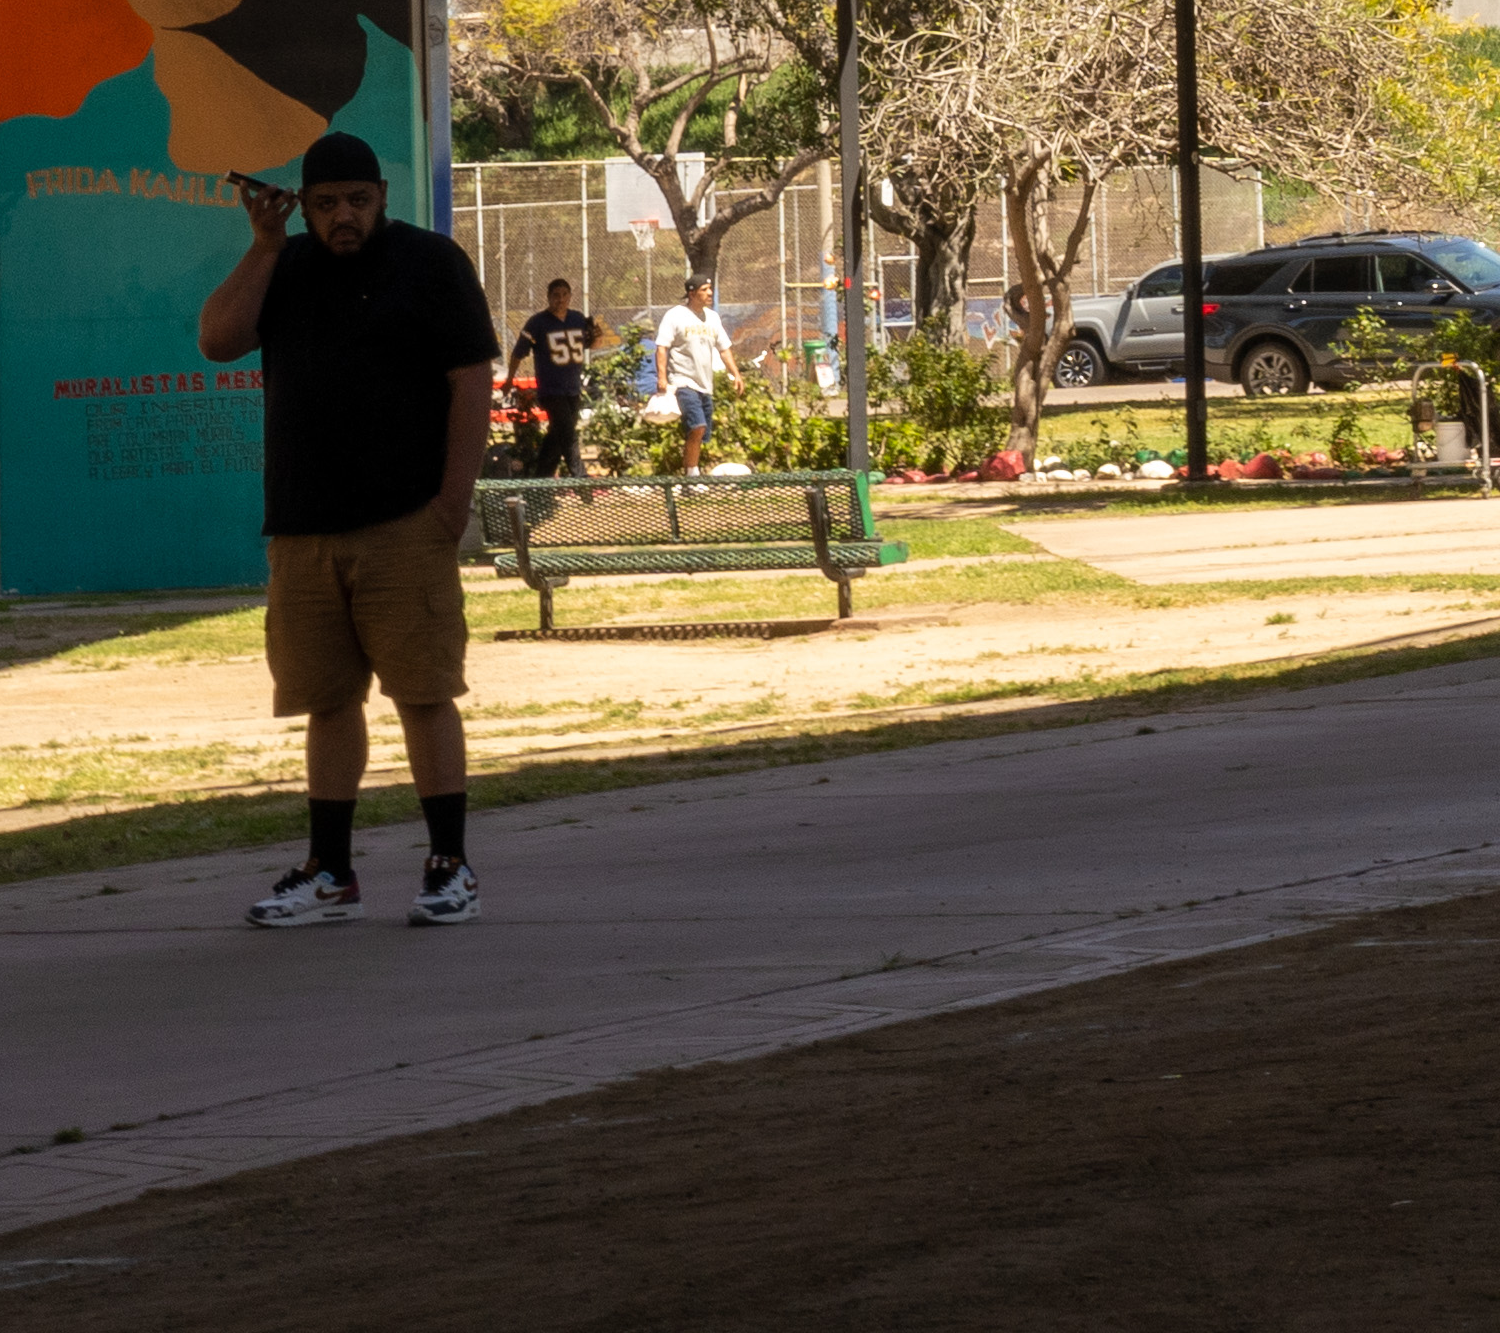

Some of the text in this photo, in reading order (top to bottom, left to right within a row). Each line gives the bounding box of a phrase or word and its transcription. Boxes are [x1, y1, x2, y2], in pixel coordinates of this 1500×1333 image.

[25, 165, 241, 209] FRIDA KAHLO
[547, 329, 584, 366] 55
[53, 371, 263, 400] MURALISTAS MEX
